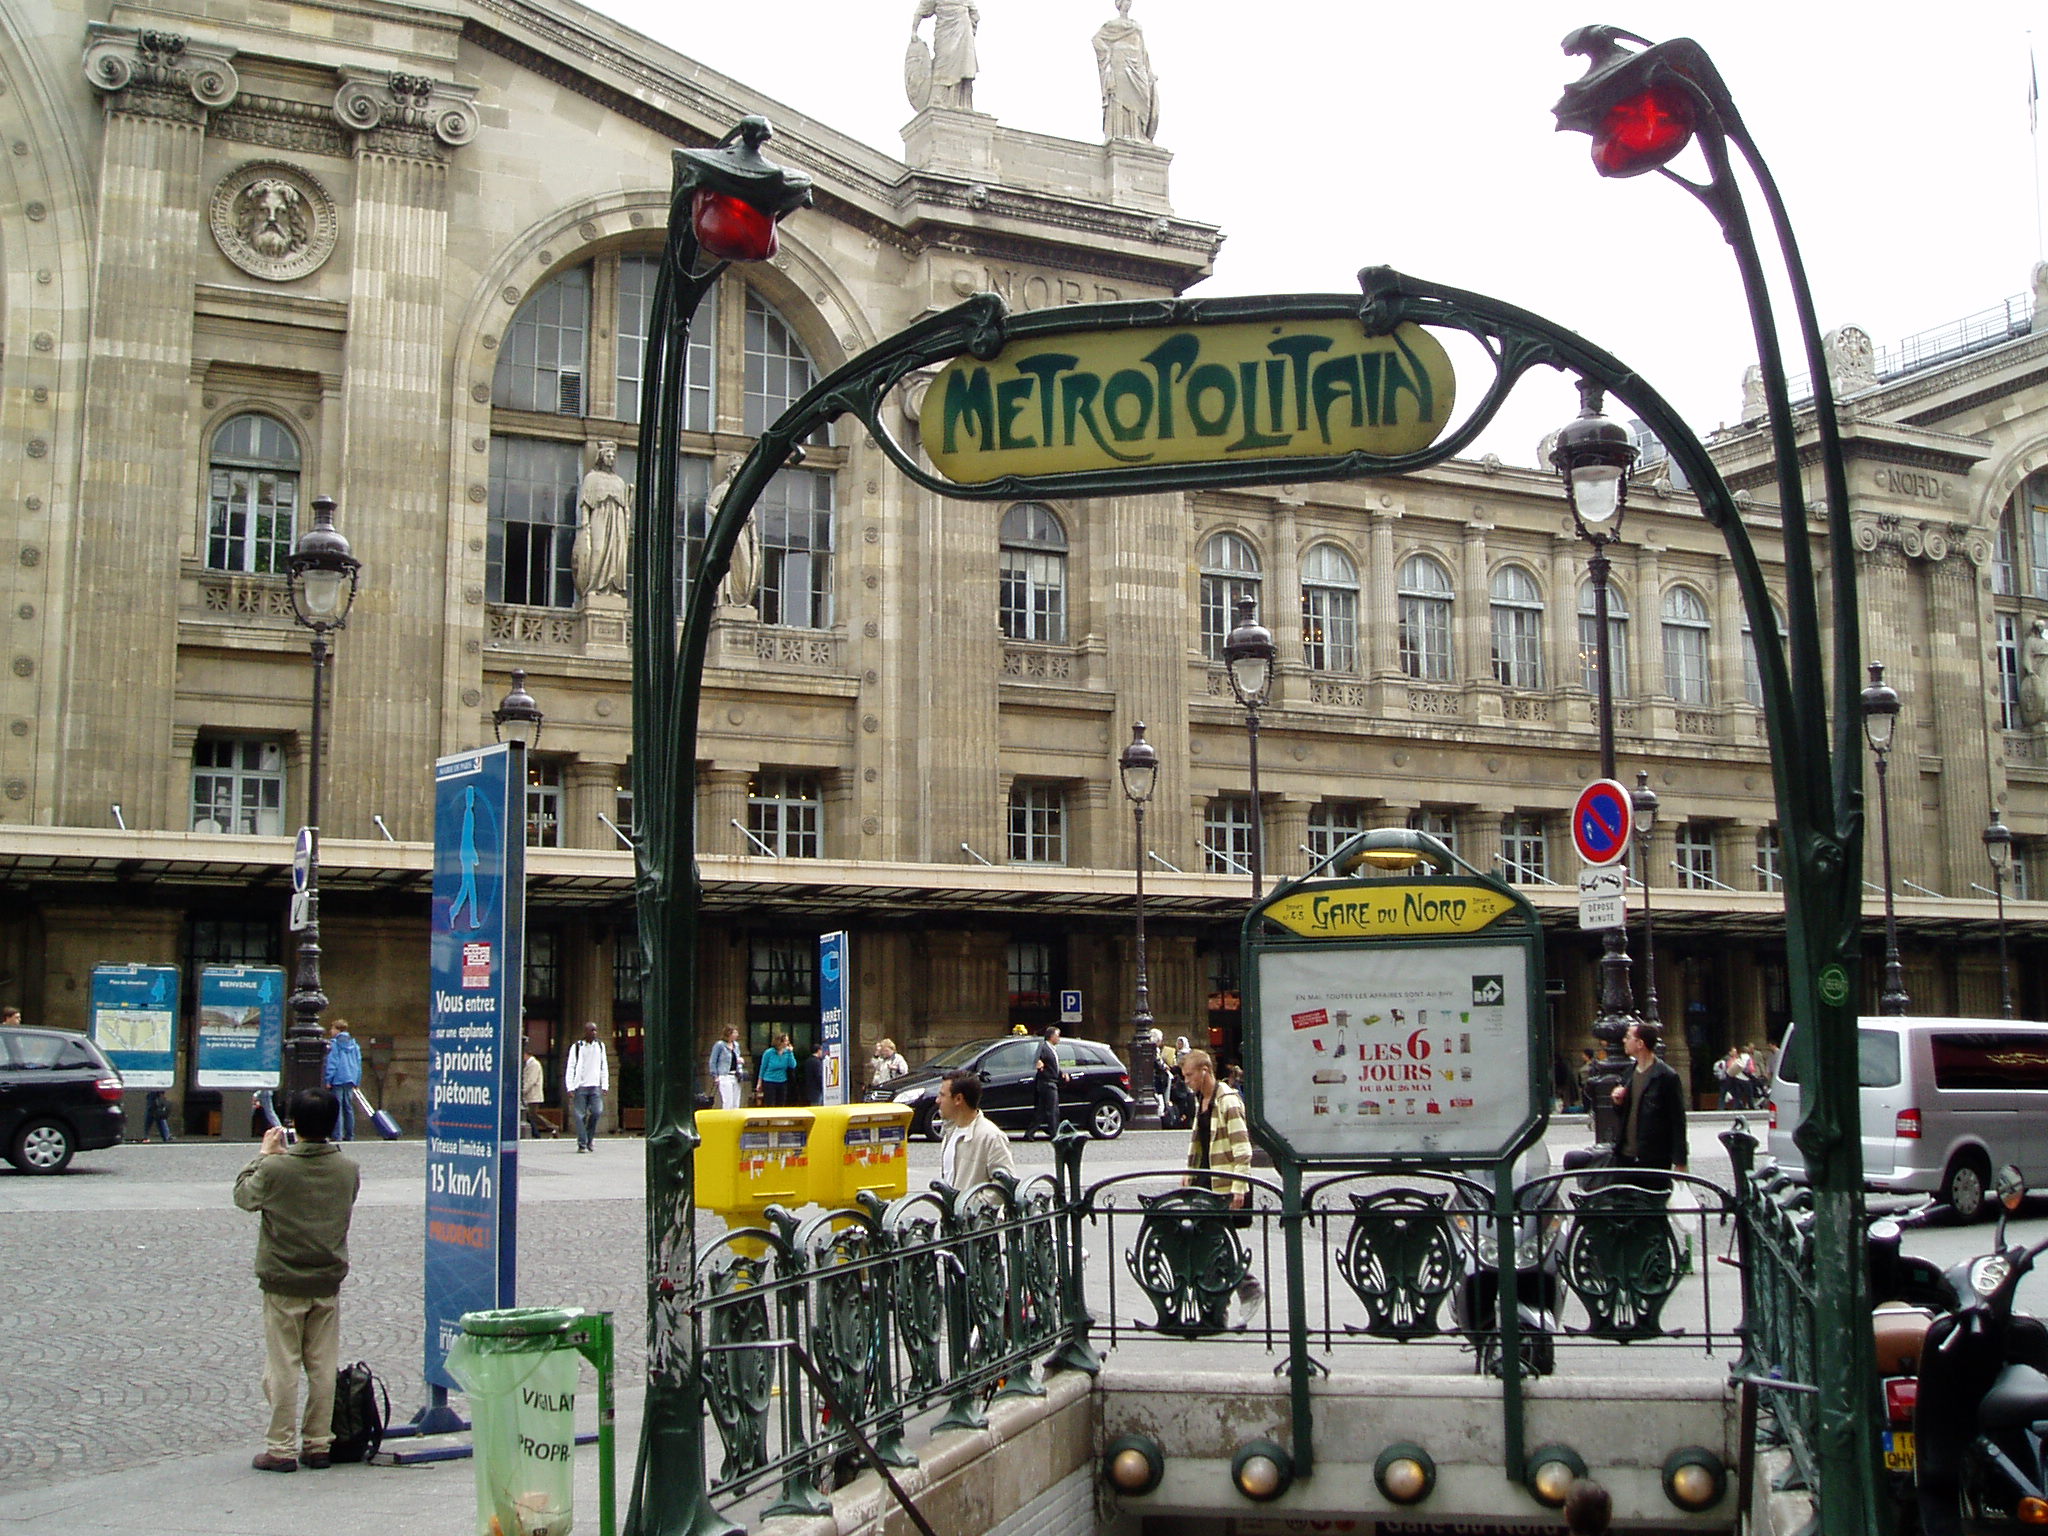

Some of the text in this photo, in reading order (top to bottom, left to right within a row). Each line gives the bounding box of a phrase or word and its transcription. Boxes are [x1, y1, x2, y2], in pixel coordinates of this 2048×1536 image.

[943, 327, 1433, 462] METROPOLITAIN
[1888, 469, 1939, 499] NORD
[219, 981, 258, 989] BIENVENUE
[436, 990, 496, 1013] Vous entrez
[1067, 995, 1076, 1010] P
[822, 1006, 841, 1024] ARRÊT
[459, 1022, 494, 1042] esplanade
[824, 1023, 840, 1039] BUS
[1359, 1028, 1431, 1060] LES 6
[435, 1045, 493, 1079] à priorité
[1358, 1064, 1432, 1081] JOURS
[434, 1079, 492, 1111] piétonne.
[431, 1137, 492, 1158] Vitesse limitée à
[431, 1162, 491, 1198] 15 km/h
[518, 1433, 571, 1462] PROPR
